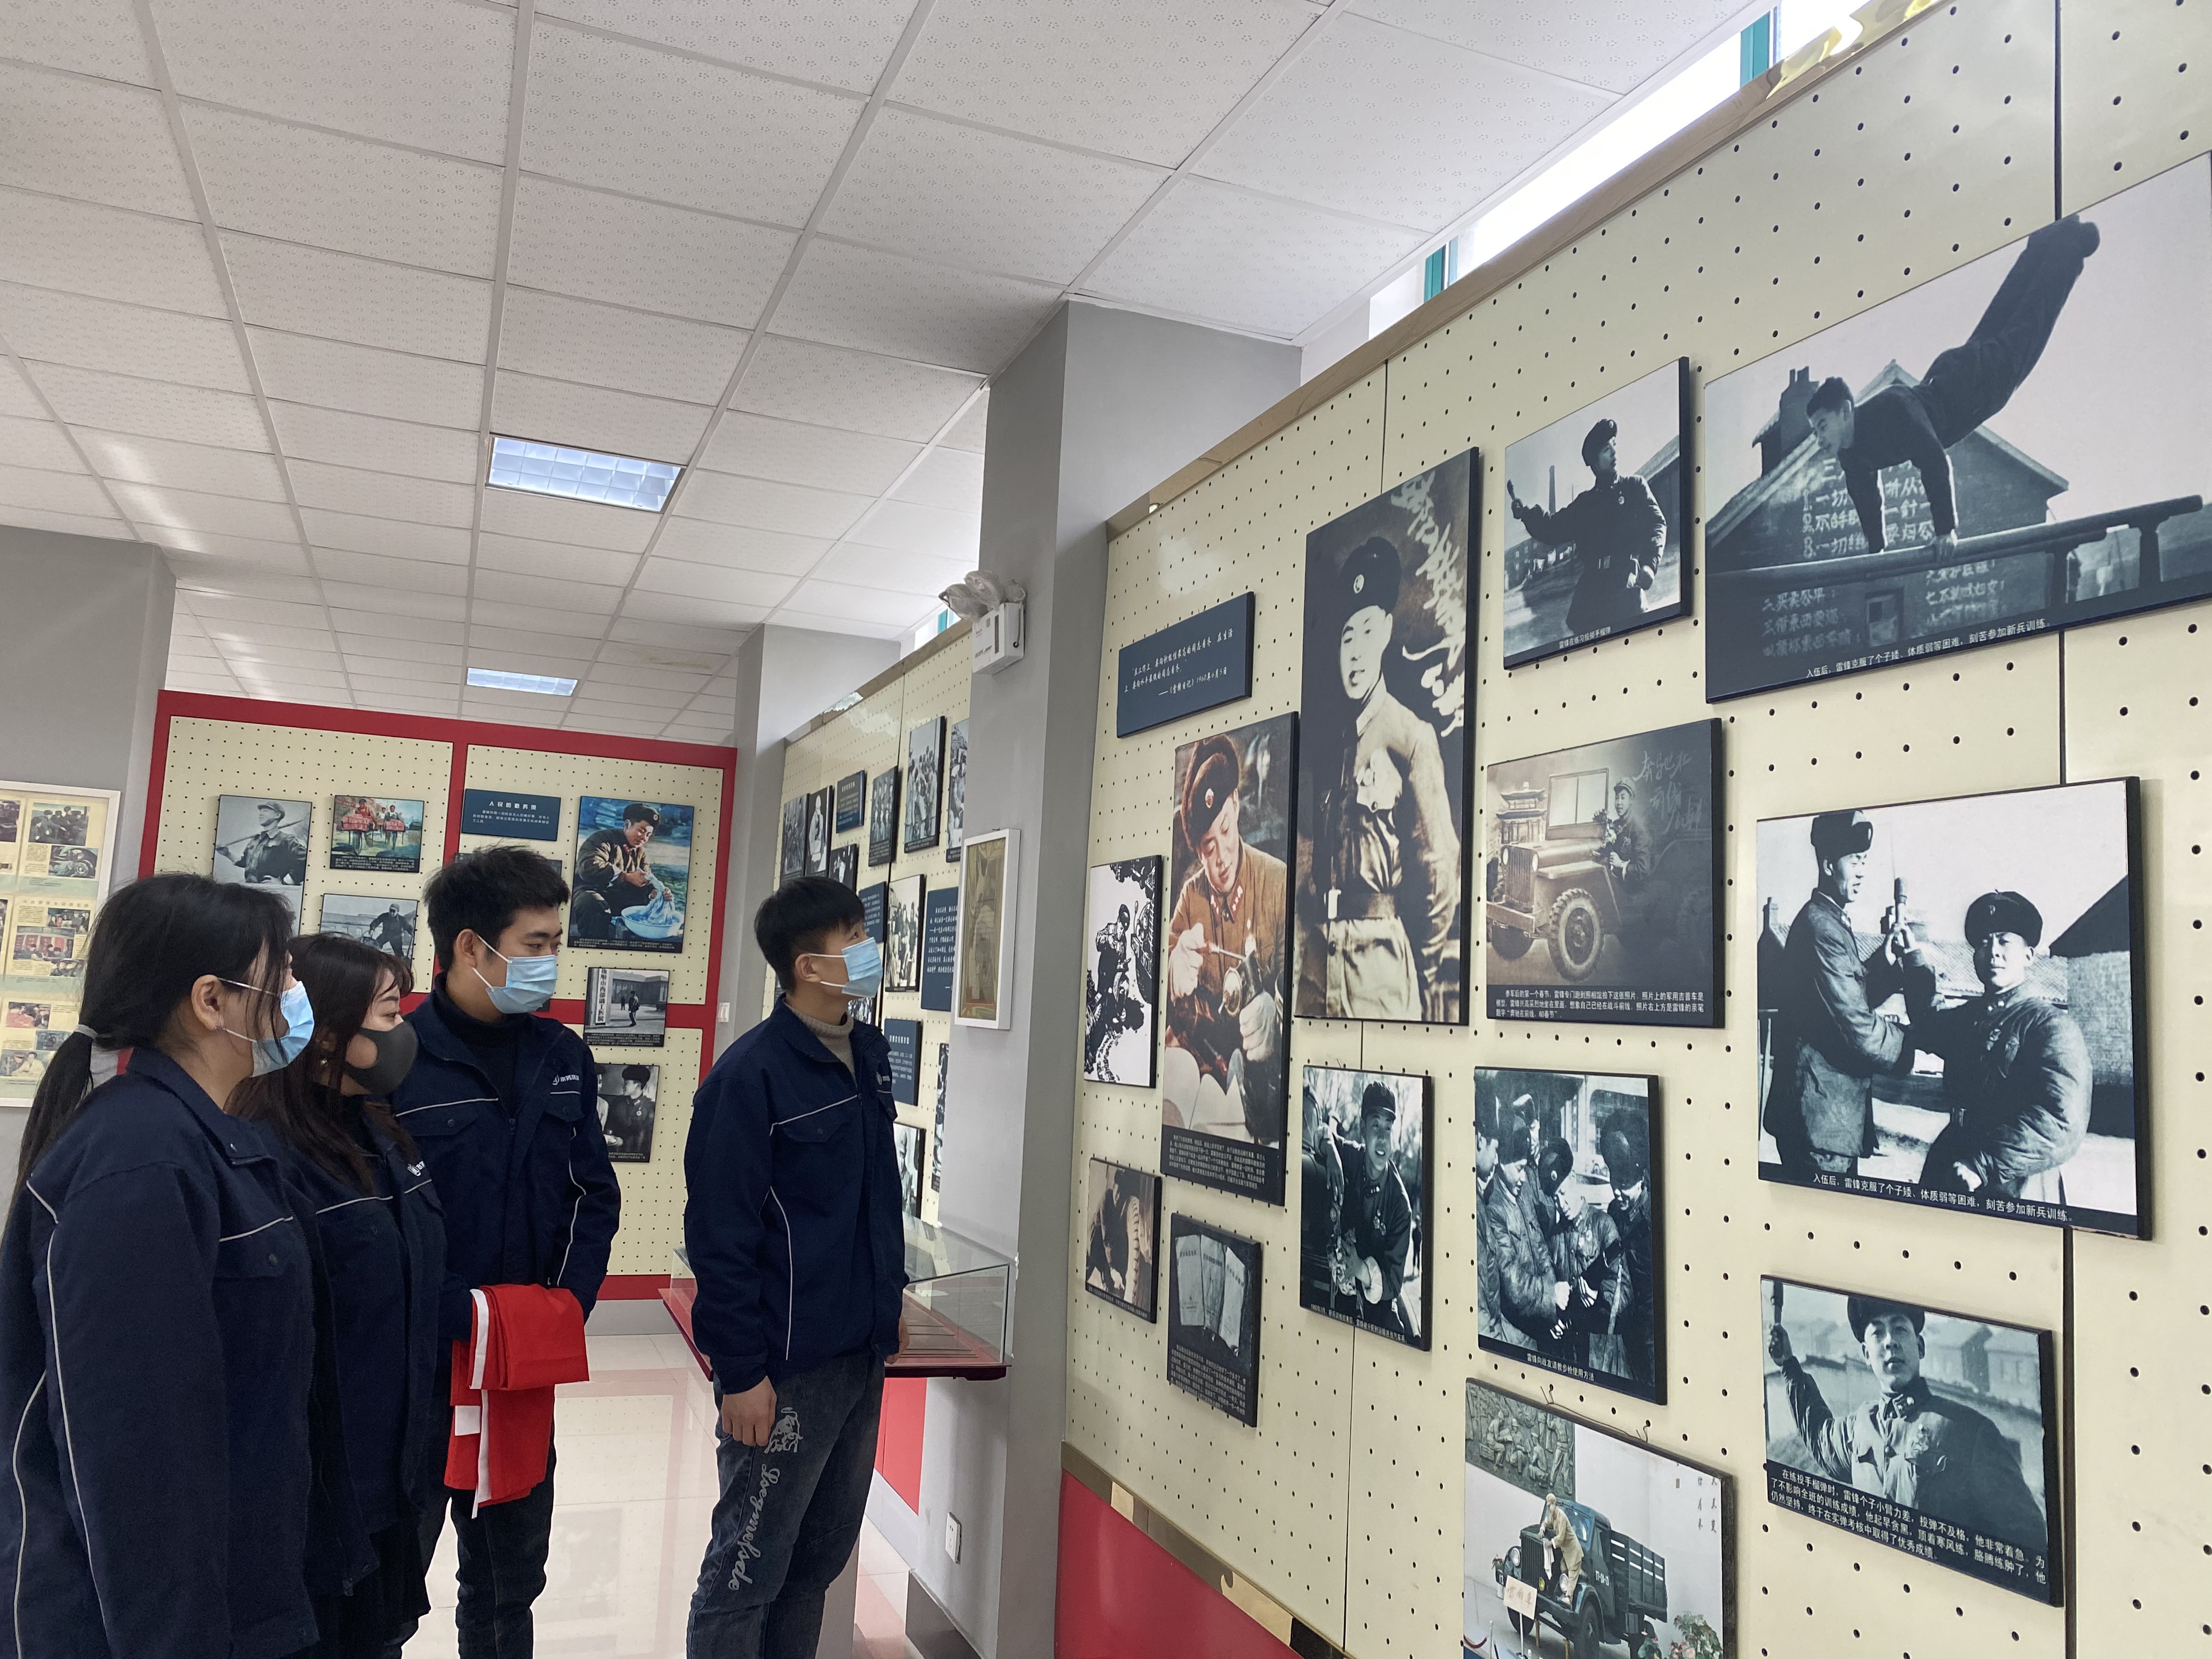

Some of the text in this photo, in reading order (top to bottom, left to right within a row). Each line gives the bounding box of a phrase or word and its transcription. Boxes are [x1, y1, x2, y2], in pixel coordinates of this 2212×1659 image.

[1806, 618, 2052, 678] 入伍后，雷锋克服了个子矮、体质弱等困难，刻苦参加新兵训练。
[1813, 1173, 2073, 1223] 入伍后，雷锋克服了个子矮、体质弱等困难，刻苦参加新兵训练。
[1527, 1352, 1595, 1381] 雷锋向战友请教步枪使用方法
